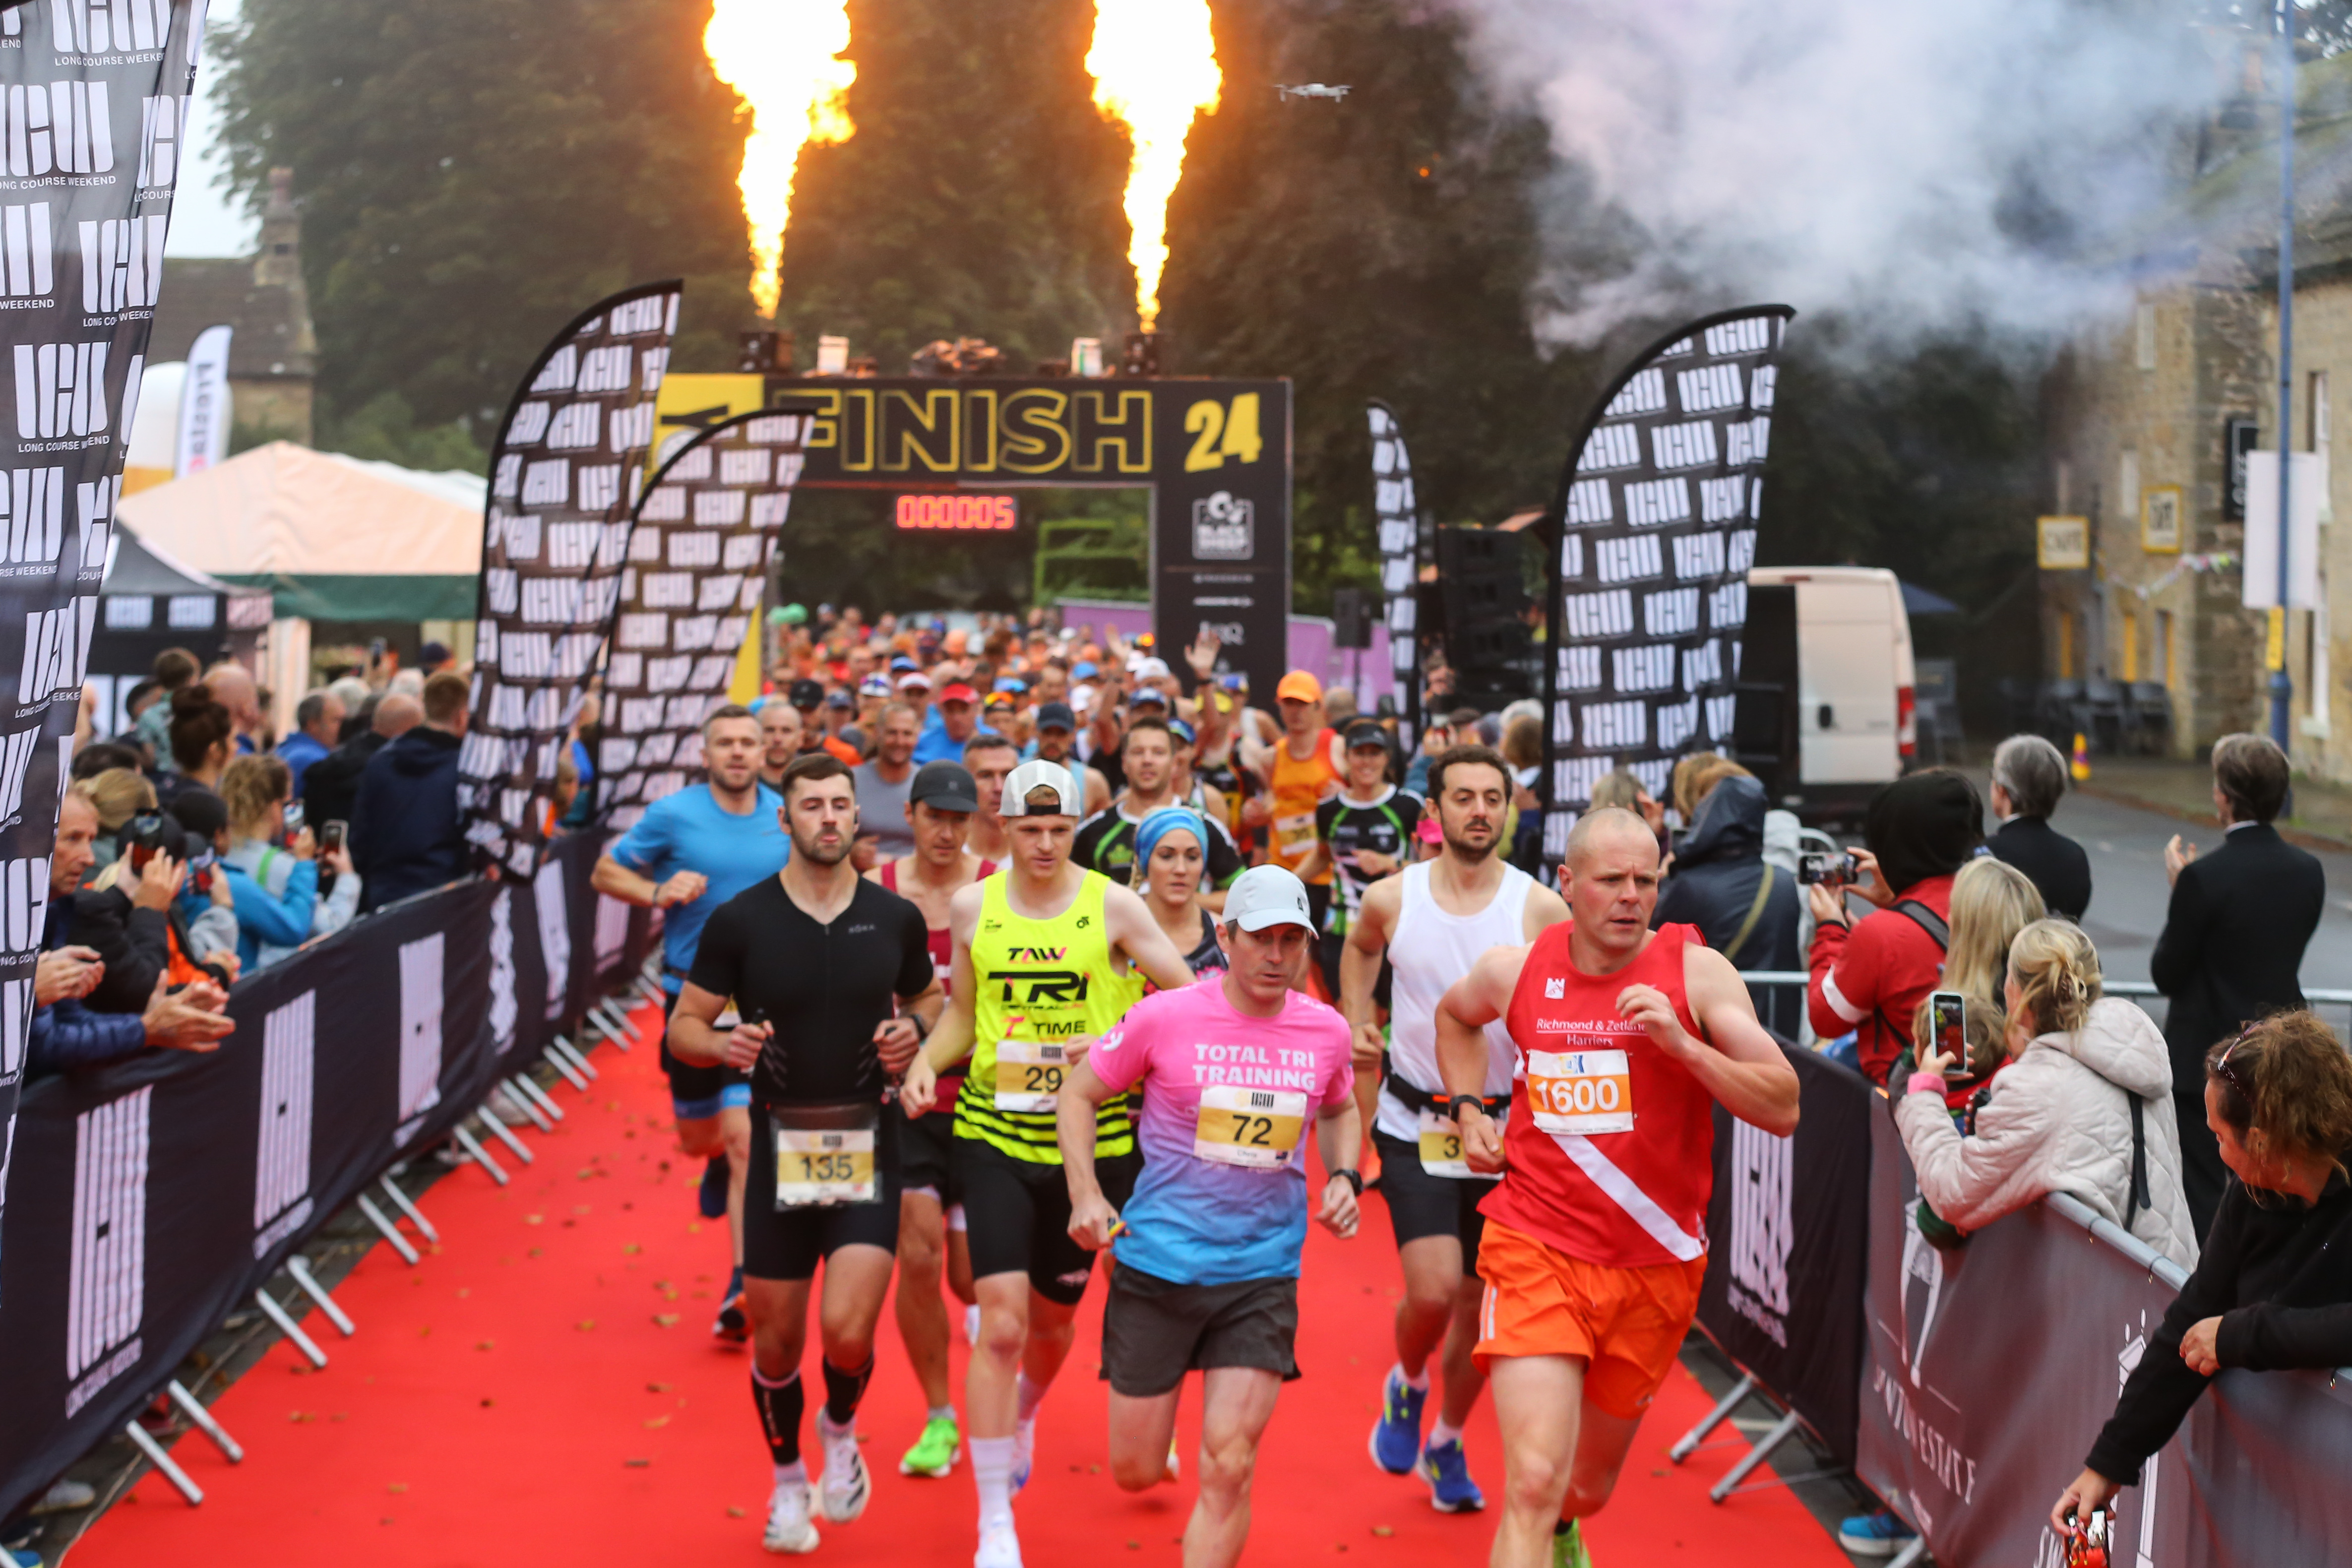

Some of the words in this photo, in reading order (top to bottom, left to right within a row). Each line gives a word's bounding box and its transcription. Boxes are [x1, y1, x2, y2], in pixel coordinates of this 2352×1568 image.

[55, 56, 82, 66] LONG
[83, 56, 124, 66] COURSE
[20, 176, 66, 190] COURSE
[68, 175, 117, 187] WEEKEND
[0, 299, 55, 310] WEEKEND
[772, 388, 1153, 473] FINISH
[1184, 392, 1263, 473] 24
[18, 442, 44, 453] LONG
[988, 971, 1090, 1003] TRI
[1034, 1020, 1086, 1035] TIME
[1537, 1018, 1594, 1030] Richmond
[1595, 1020, 1605, 1031] &
[1567, 1034, 1613, 1046] Harriers
[1194, 1043, 1270, 1065] TOTAL
[1278, 1049, 1315, 1068] TRI
[1026, 1066, 1062, 1092] 29
[1192, 1065, 1316, 1091] TRAINING
[1536, 1078, 1619, 1113] 1600
[1233, 1114, 1272, 1145] 72
[800, 1155, 854, 1181] 135
